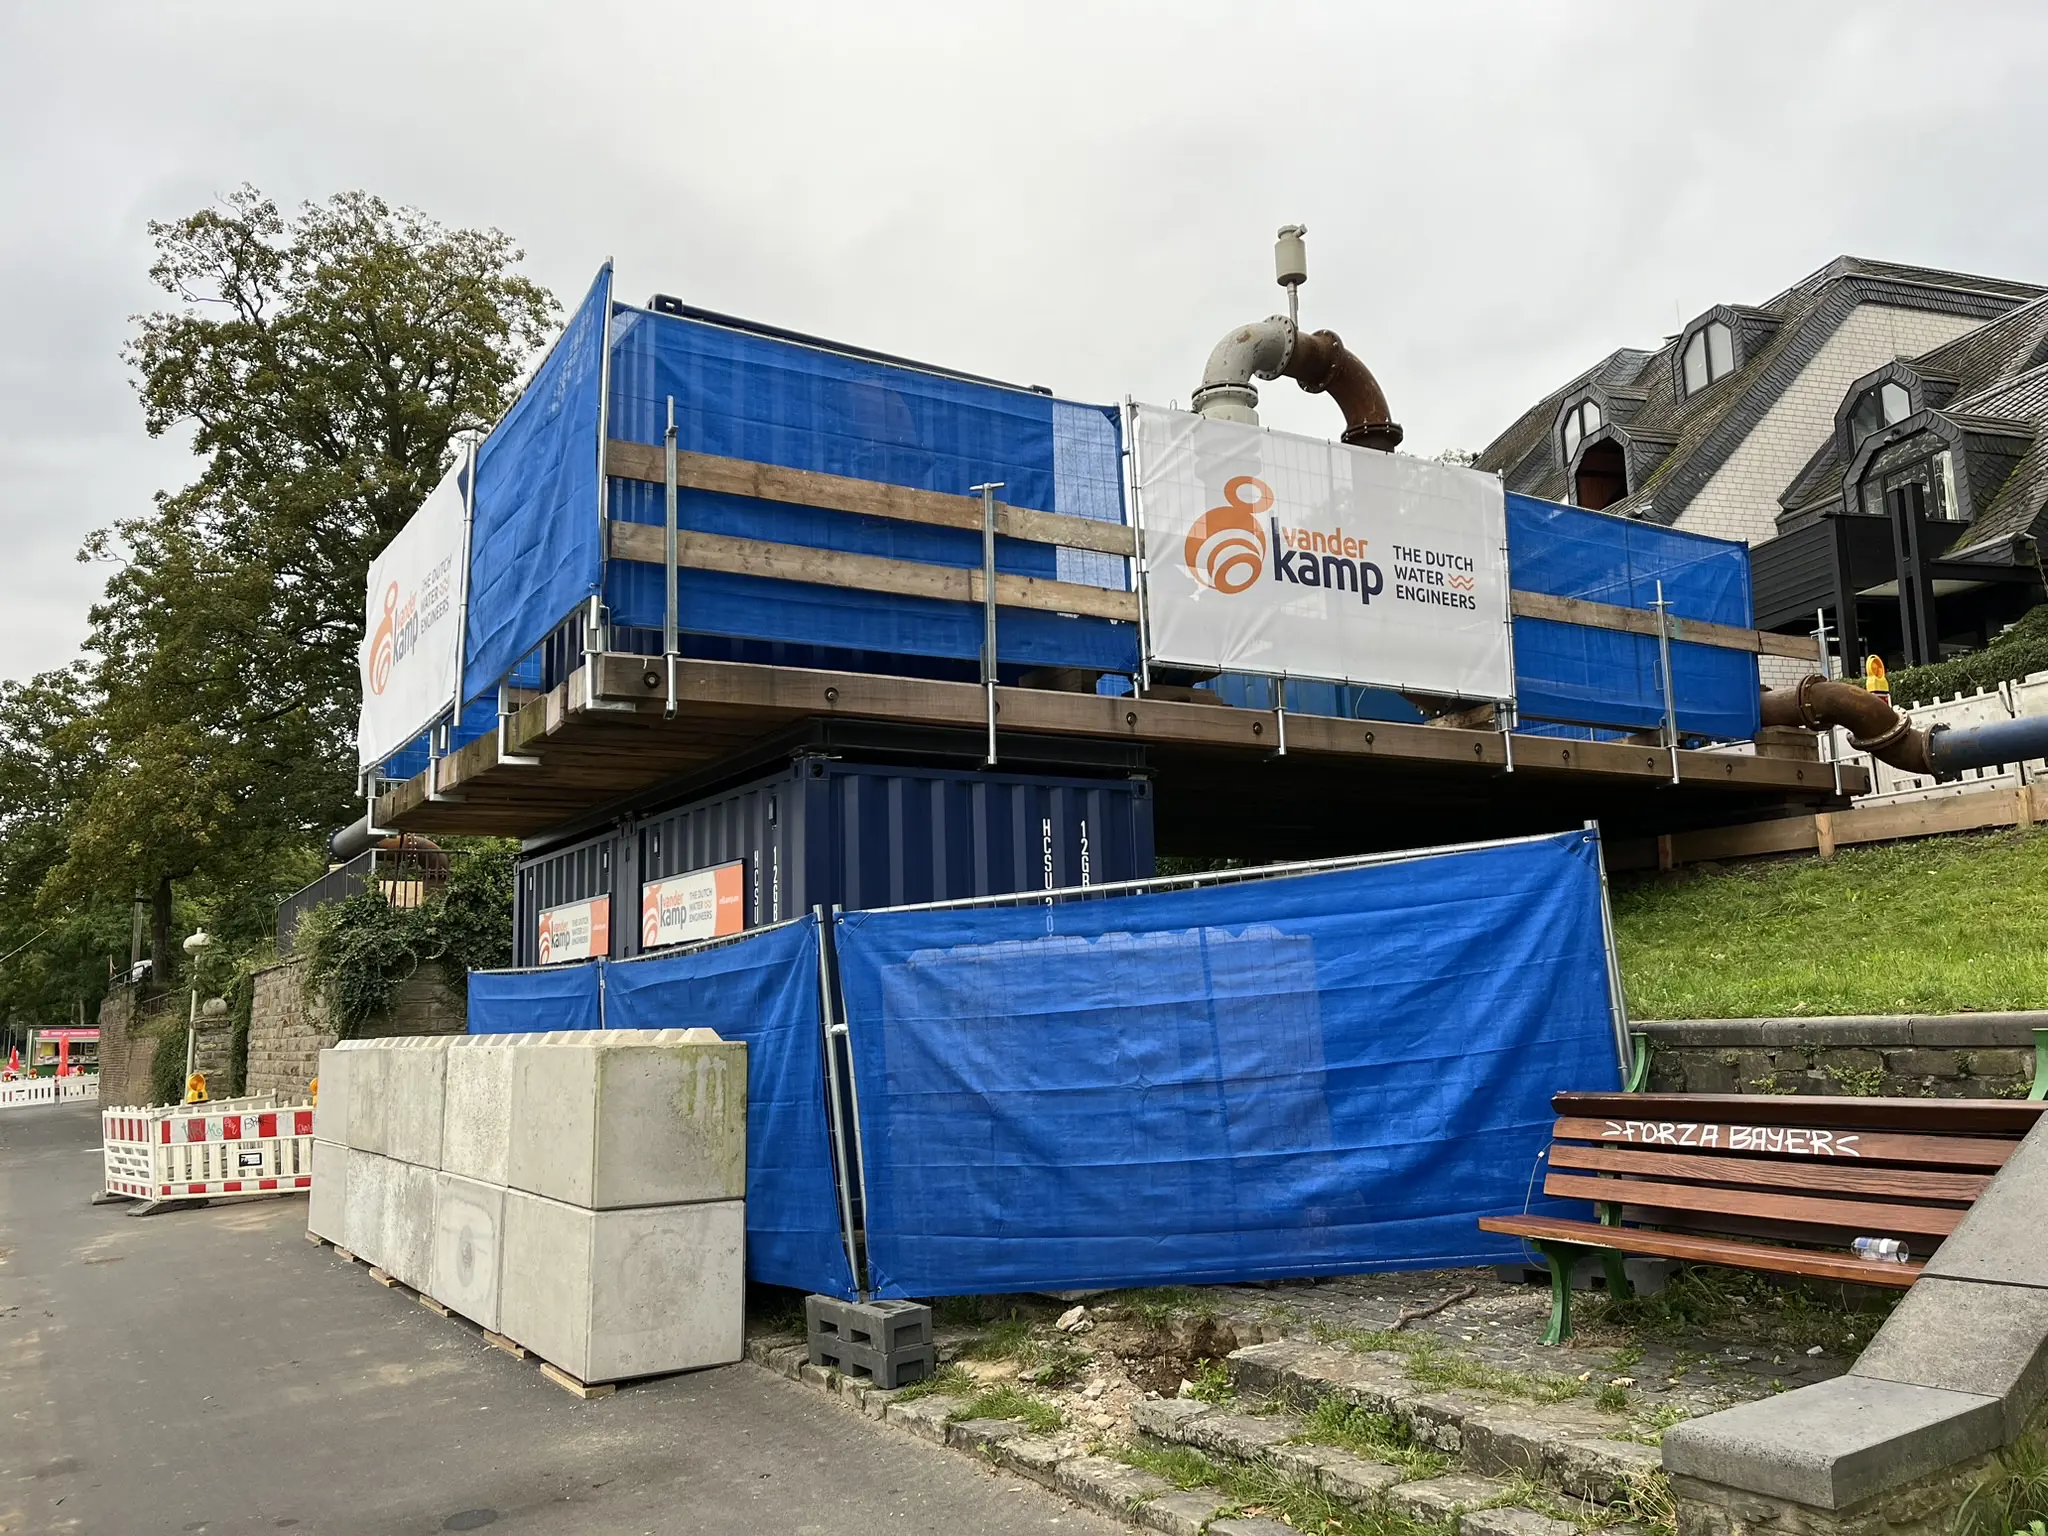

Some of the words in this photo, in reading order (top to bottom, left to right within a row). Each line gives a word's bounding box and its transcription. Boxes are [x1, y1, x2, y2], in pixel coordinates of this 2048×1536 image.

[1282, 526, 1368, 559] vander
[432, 554, 452, 580] DUTCH
[1271, 516, 1384, 605] kamp
[1393, 545, 1422, 564] THE
[1425, 551, 1474, 572] DUTCH
[1394, 564, 1444, 587] WATER
[420, 586, 438, 613] WATER
[1396, 585, 1476, 610] ENGINEERS
[420, 596, 450, 635] ENGINEERS
[392, 609, 419, 667] kamp
[1042, 818, 1053, 890] HCSU
[660, 894, 687, 930] kamp
[663, 891, 684, 908] vander
[688, 910, 712, 923] ENGINEERS
[551, 921, 570, 951] kamp
[1623, 1120, 1719, 1148] FORZA
[1729, 1125, 1834, 1156] BAYER
